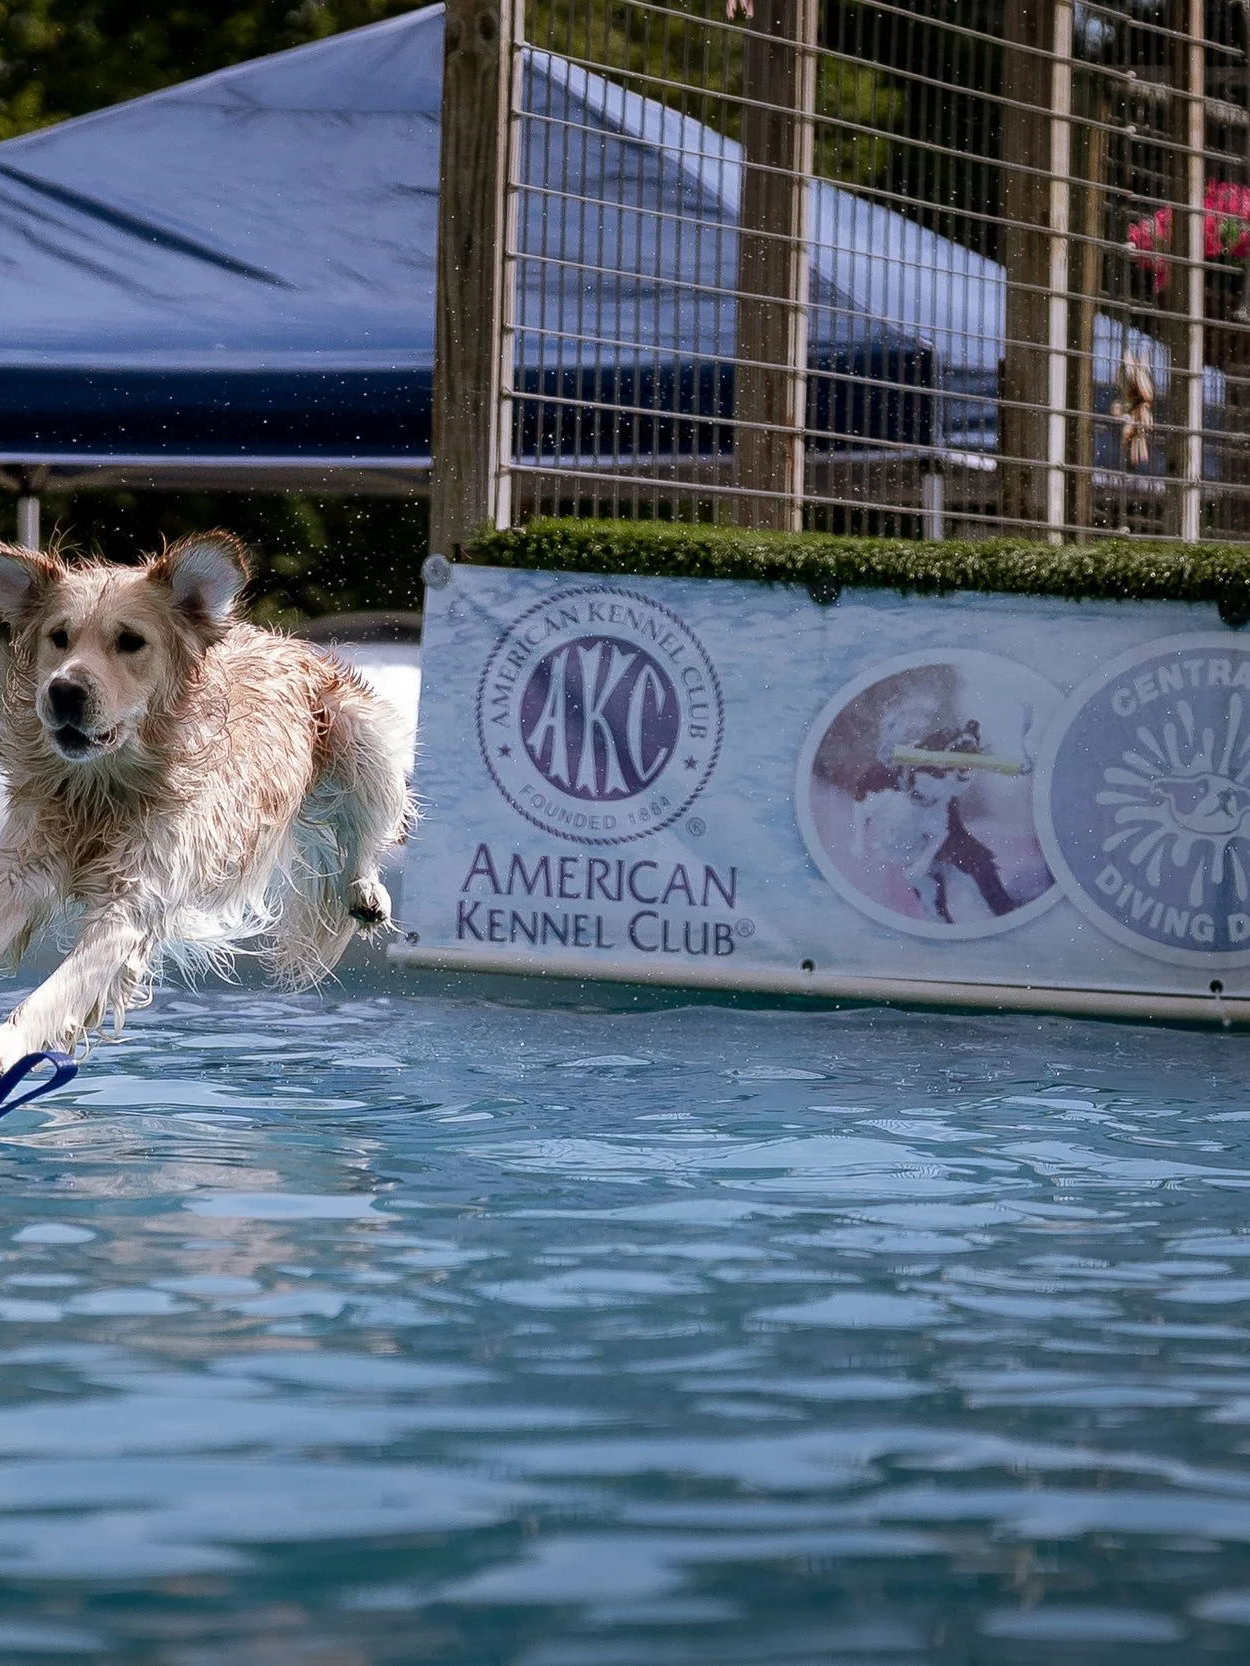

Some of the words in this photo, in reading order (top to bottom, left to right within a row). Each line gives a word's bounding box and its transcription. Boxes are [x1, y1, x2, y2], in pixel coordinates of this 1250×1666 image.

[490, 605, 581, 729] AMERICAN
[588, 602, 687, 665] KENNEL
[680, 666, 710, 740] CLUB
[526, 640, 669, 798] AKC
[518, 783, 617, 831] FOUNDED
[459, 842, 738, 910] AMERICAN
[1095, 863, 1215, 943] DIVING
[457, 900, 616, 949] KENNEL
